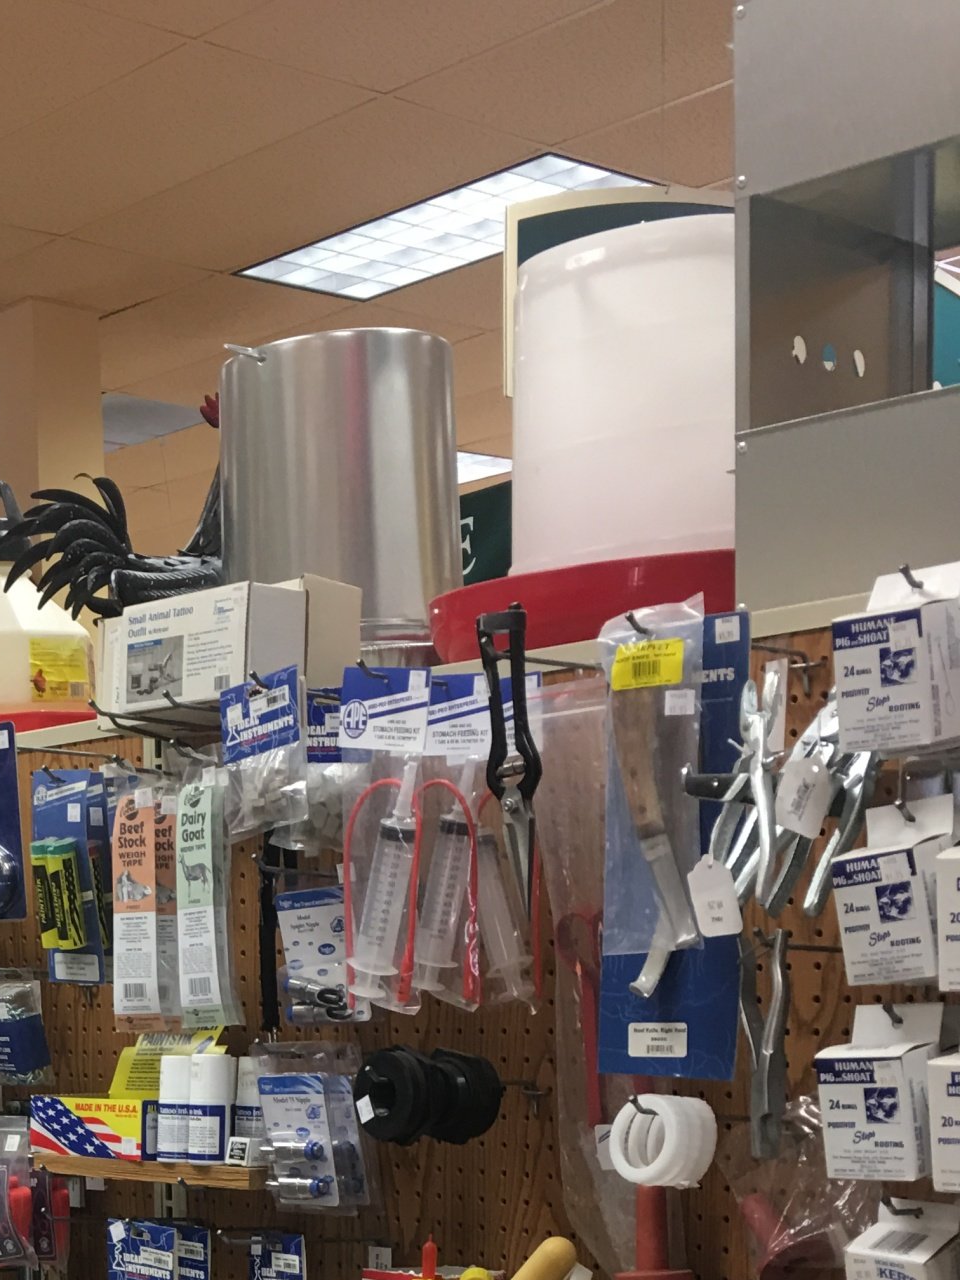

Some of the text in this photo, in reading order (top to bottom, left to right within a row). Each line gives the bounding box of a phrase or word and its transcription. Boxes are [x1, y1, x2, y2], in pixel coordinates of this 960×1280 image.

[128, 605, 194, 626] Small Animal Tattoo
[128, 627, 147, 639] Outfit
[835, 630, 888, 648] PIG SHOAT
[843, 666, 855, 678] 24
[866, 695, 921, 712] Stops ROOTING
[237, 715, 259, 730] IDEAL
[345, 704, 367, 730] APE
[239, 715, 294, 741] INSTRUMENTS
[458, 729, 480, 737] FEEDING
[181, 811, 206, 826] Dairy
[119, 822, 144, 835] Beef
[117, 835, 146, 849] Stock
[181, 830, 205, 843] Goat
[118, 851, 146, 860] WEIGH
[122, 859, 143, 867] TAPE
[833, 877, 847, 886] PIG
[843, 903, 855, 914] 24
[869, 930, 922, 947] Stops ROOTING
[820, 1072, 872, 1082] PIG SHOAT
[75, 1103, 138, 1113] MADE IN THE U.S.A.
[829, 1099, 841, 1110] 24
[941, 1116, 954, 1127] 20
[853, 1131, 875, 1144] Stops
[125, 1264, 171, 1280] INSTRUMENTS
